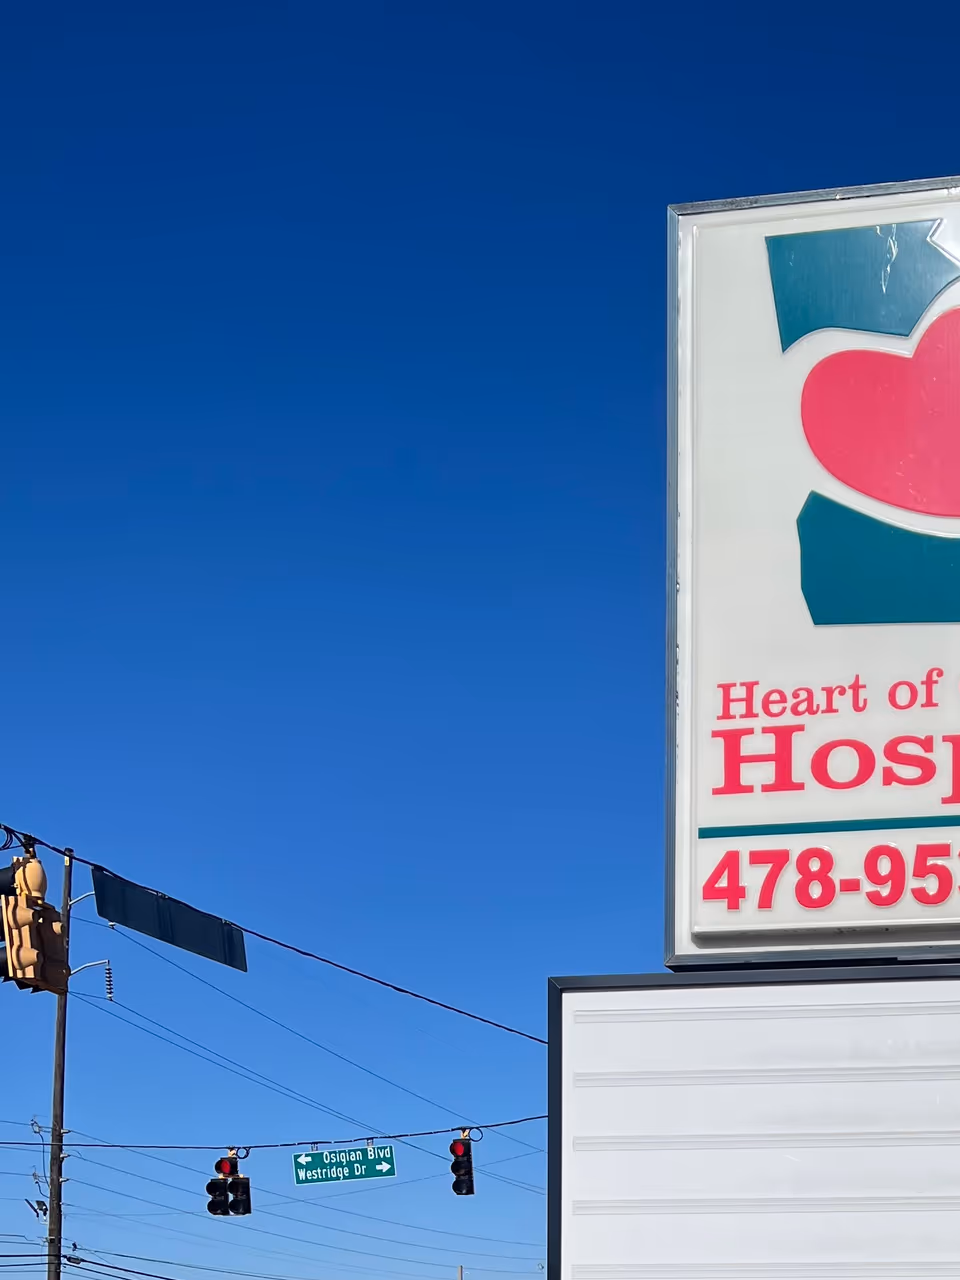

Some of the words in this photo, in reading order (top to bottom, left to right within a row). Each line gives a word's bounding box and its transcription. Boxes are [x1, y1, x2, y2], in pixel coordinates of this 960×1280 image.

[717, 673, 867, 720] Heart
[888, 668, 944, 710] of
[323, 1150, 362, 1166] Osigian
[367, 1147, 391, 1159] Blvd
[298, 1166, 349, 1180] Westridge
[354, 1163, 367, 1175] Dr
